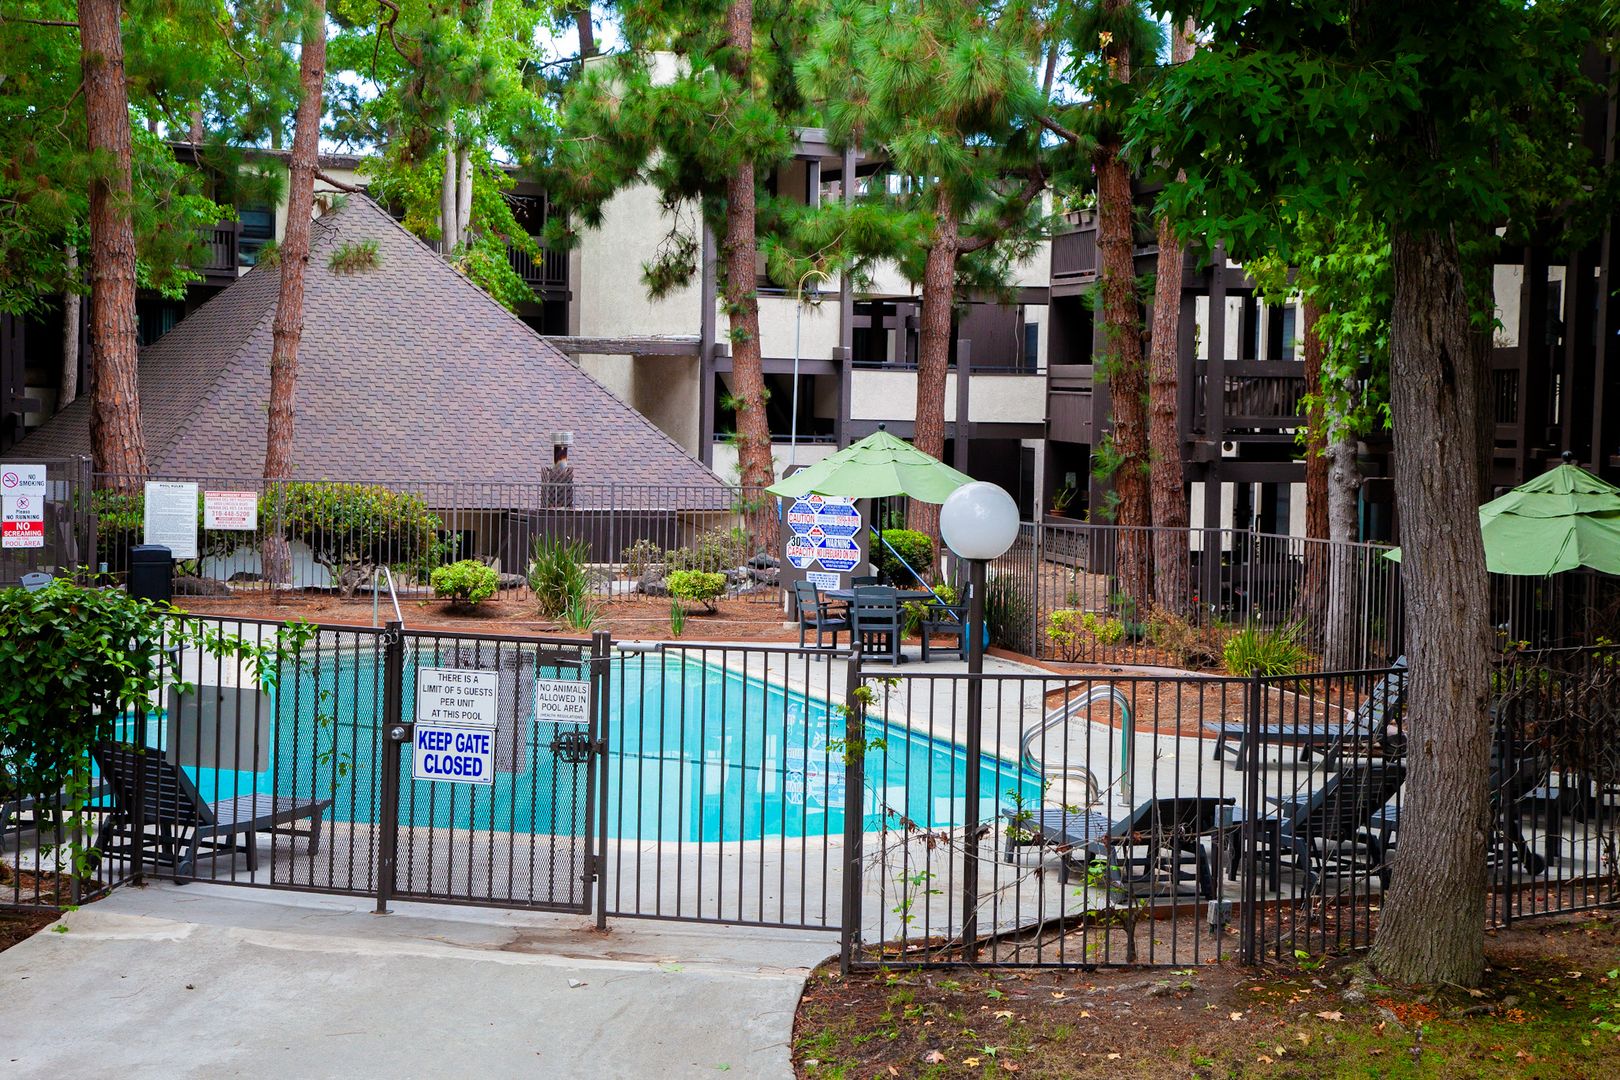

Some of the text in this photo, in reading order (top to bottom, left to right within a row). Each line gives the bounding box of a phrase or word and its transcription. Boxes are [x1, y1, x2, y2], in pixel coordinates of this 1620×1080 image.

[788, 514, 815, 523] CAUTION
[16, 522, 30, 531] NO
[791, 536, 800, 547] 30
[825, 539, 851, 549] WARNING
[787, 547, 815, 558] CAPACITY
[816, 550, 823, 558] NO
[823, 549, 842, 559] LIFEGUARD
[842, 551, 849, 559] ON
[438, 673, 462, 682] THERE
[464, 675, 471, 683] IS
[422, 684, 493, 697] LIMIT OF 5 GUESTS
[553, 684, 587, 694] ANIMALS
[440, 697, 475, 707] PER UNIT
[539, 693, 586, 703] ALLOWED IN
[541, 703, 584, 713] POOL AREA
[431, 709, 483, 720] AT THIS POOL
[418, 730, 490, 754] KEEP GATE
[423, 754, 483, 777] CLOSED
